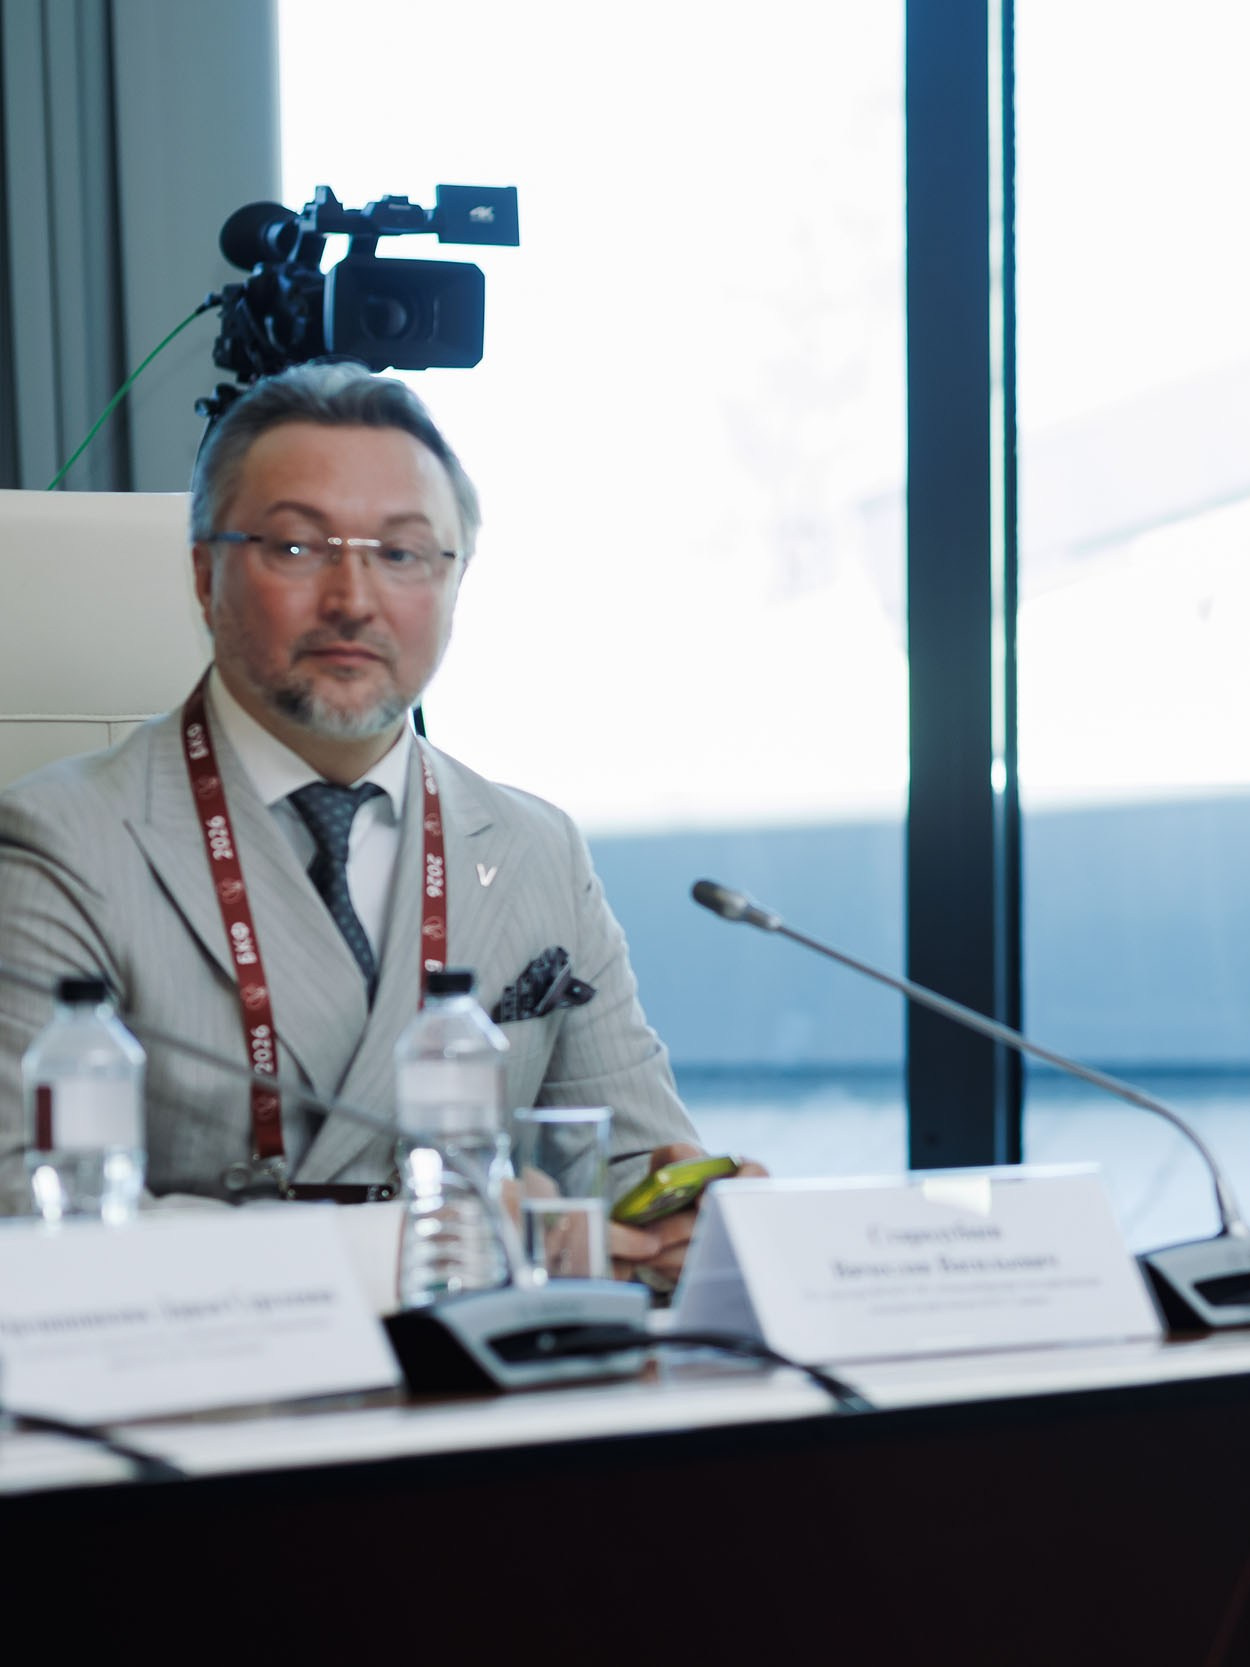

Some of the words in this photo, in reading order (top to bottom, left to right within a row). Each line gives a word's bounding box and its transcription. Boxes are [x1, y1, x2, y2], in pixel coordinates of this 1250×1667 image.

[206, 815, 233, 861] 2026
[426, 853, 443, 898] 2026
[230, 921, 257, 965] БКФ
[250, 1024, 274, 1074] 2026
